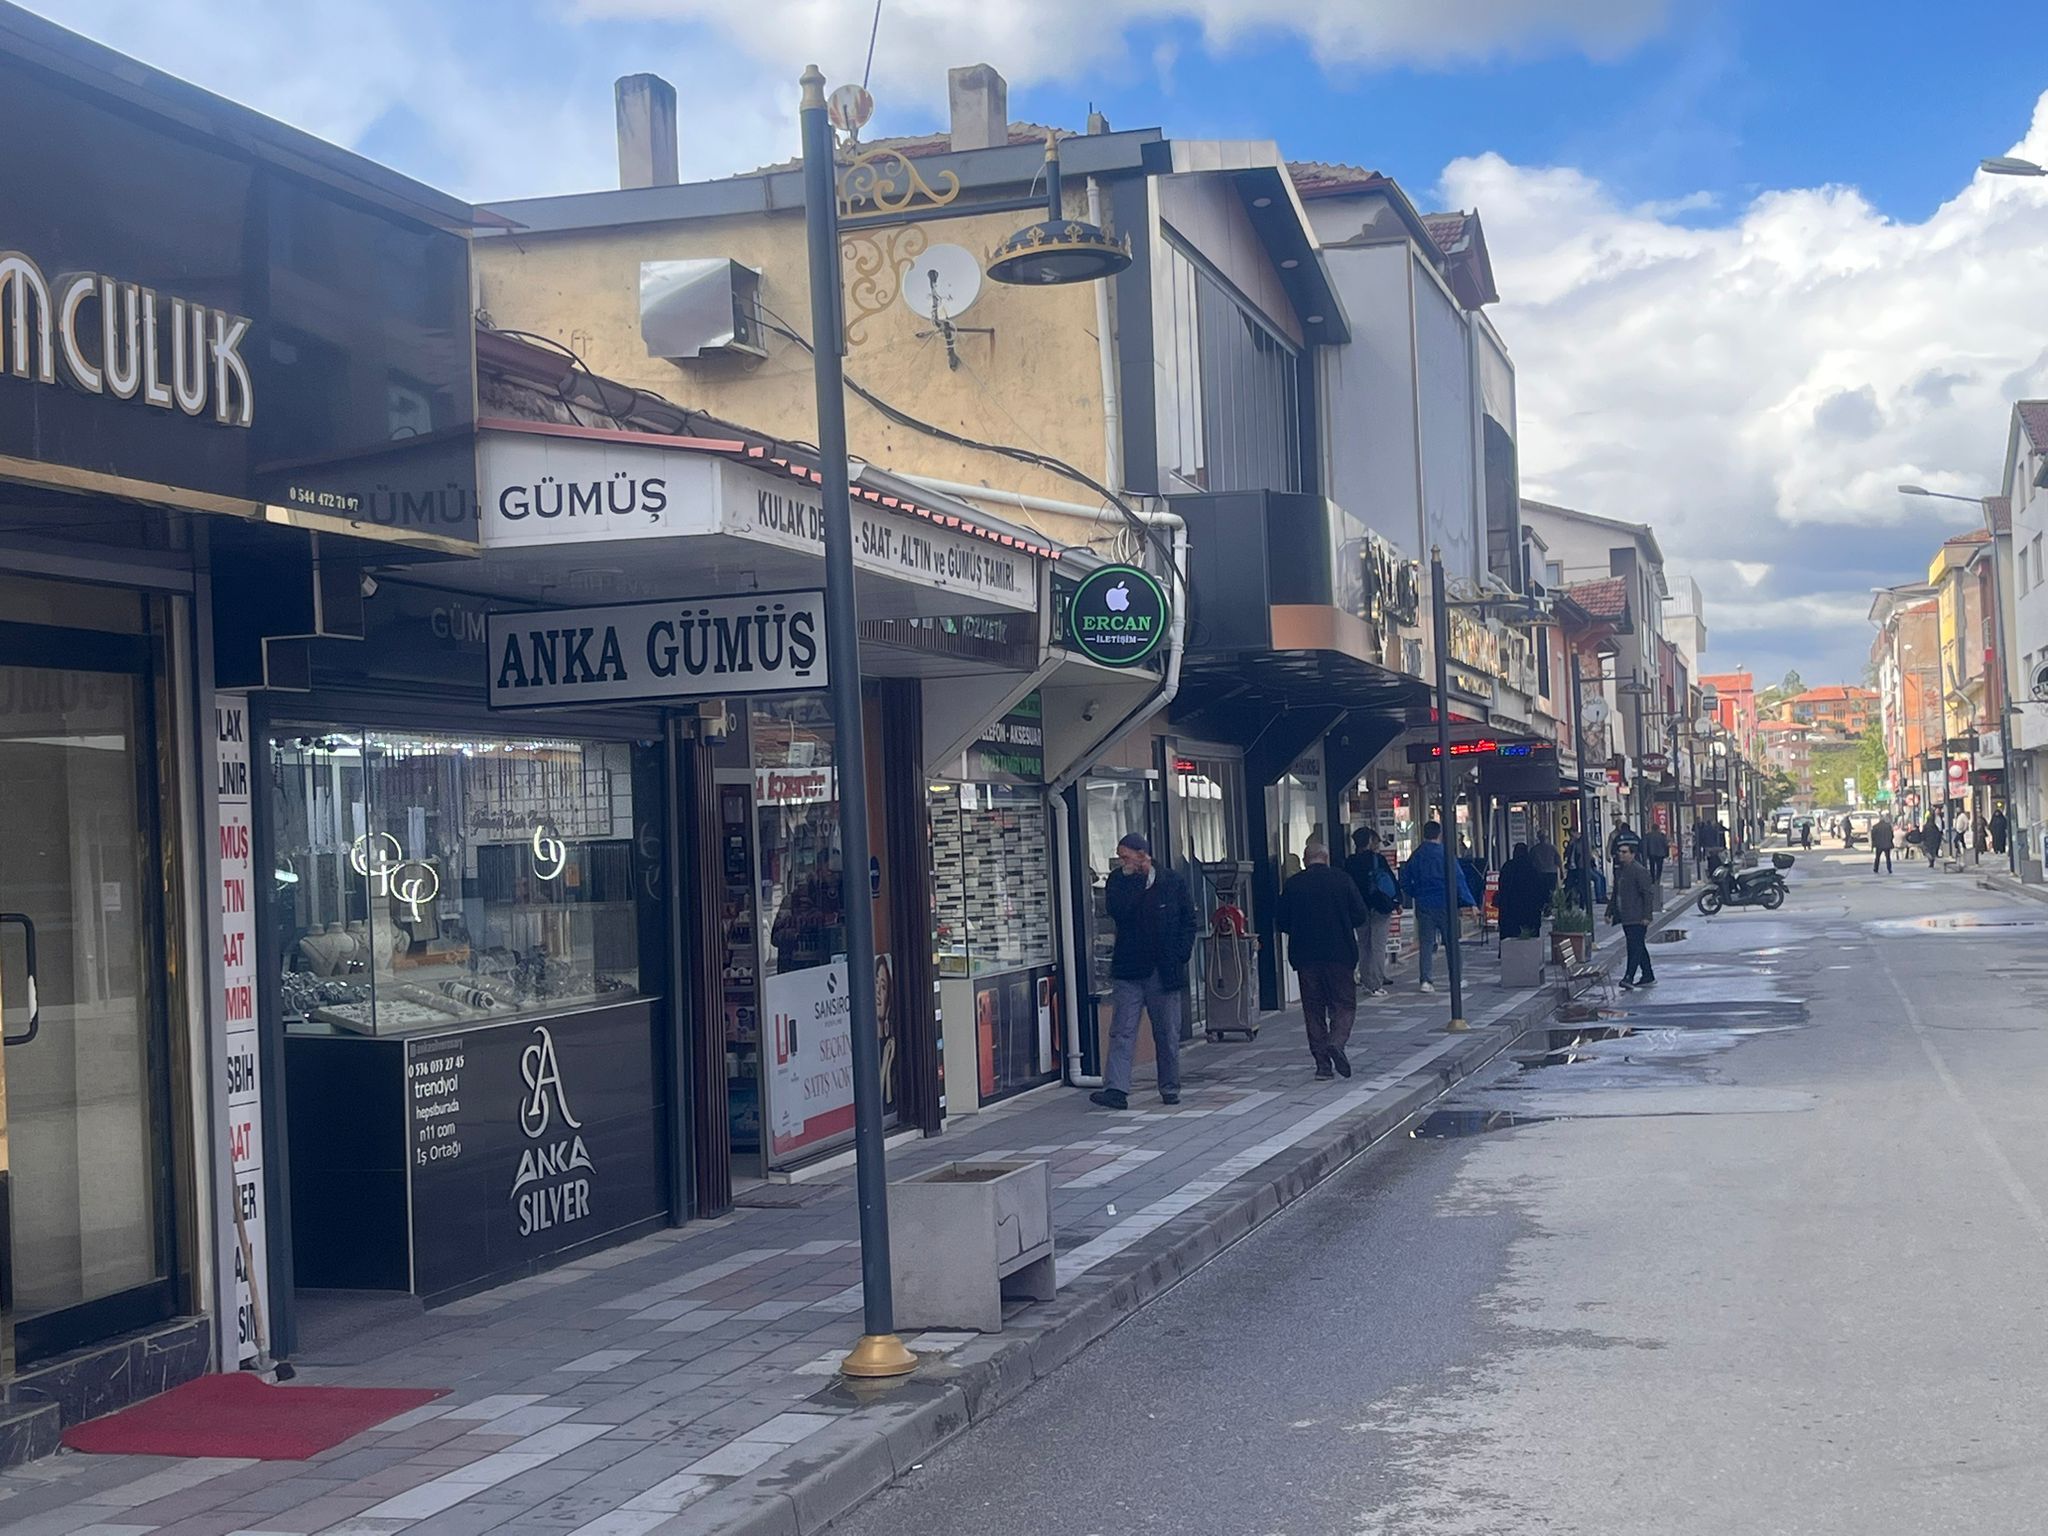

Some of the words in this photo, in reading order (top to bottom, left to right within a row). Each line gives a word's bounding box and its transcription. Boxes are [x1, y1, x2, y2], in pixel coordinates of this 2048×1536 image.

[298, 489, 315, 504] 544
[318, 493, 334, 507] 472
[499, 471, 667, 523] GÜMÜŞ
[758, 489, 807, 539] KULAK
[861, 521, 892, 561] SAAT
[900, 534, 931, 572] ALTIN
[934, 551, 945, 576] ve
[948, 544, 981, 592] GÜMÜŞ
[984, 556, 1014, 592] TAMİRİ
[1083, 616, 1152, 631] ERCAN
[497, 626, 628, 689] ANKA
[646, 603, 817, 678] GÜMÜŞ
[1096, 634, 1137, 645] İLETİŞİM
[415, 1062, 429, 1077] 536
[430, 1059, 443, 1074] 033
[445, 1057, 454, 1071] 27
[455, 1055, 465, 1069] 45
[415, 1073, 458, 1099] trendyol
[416, 1098, 460, 1122] hepsiburada
[420, 1124, 435, 1142] n11
[430, 1140, 461, 1161] Ortağı
[510, 1135, 597, 1199] ANKA
[519, 1179, 591, 1236] SILVER
